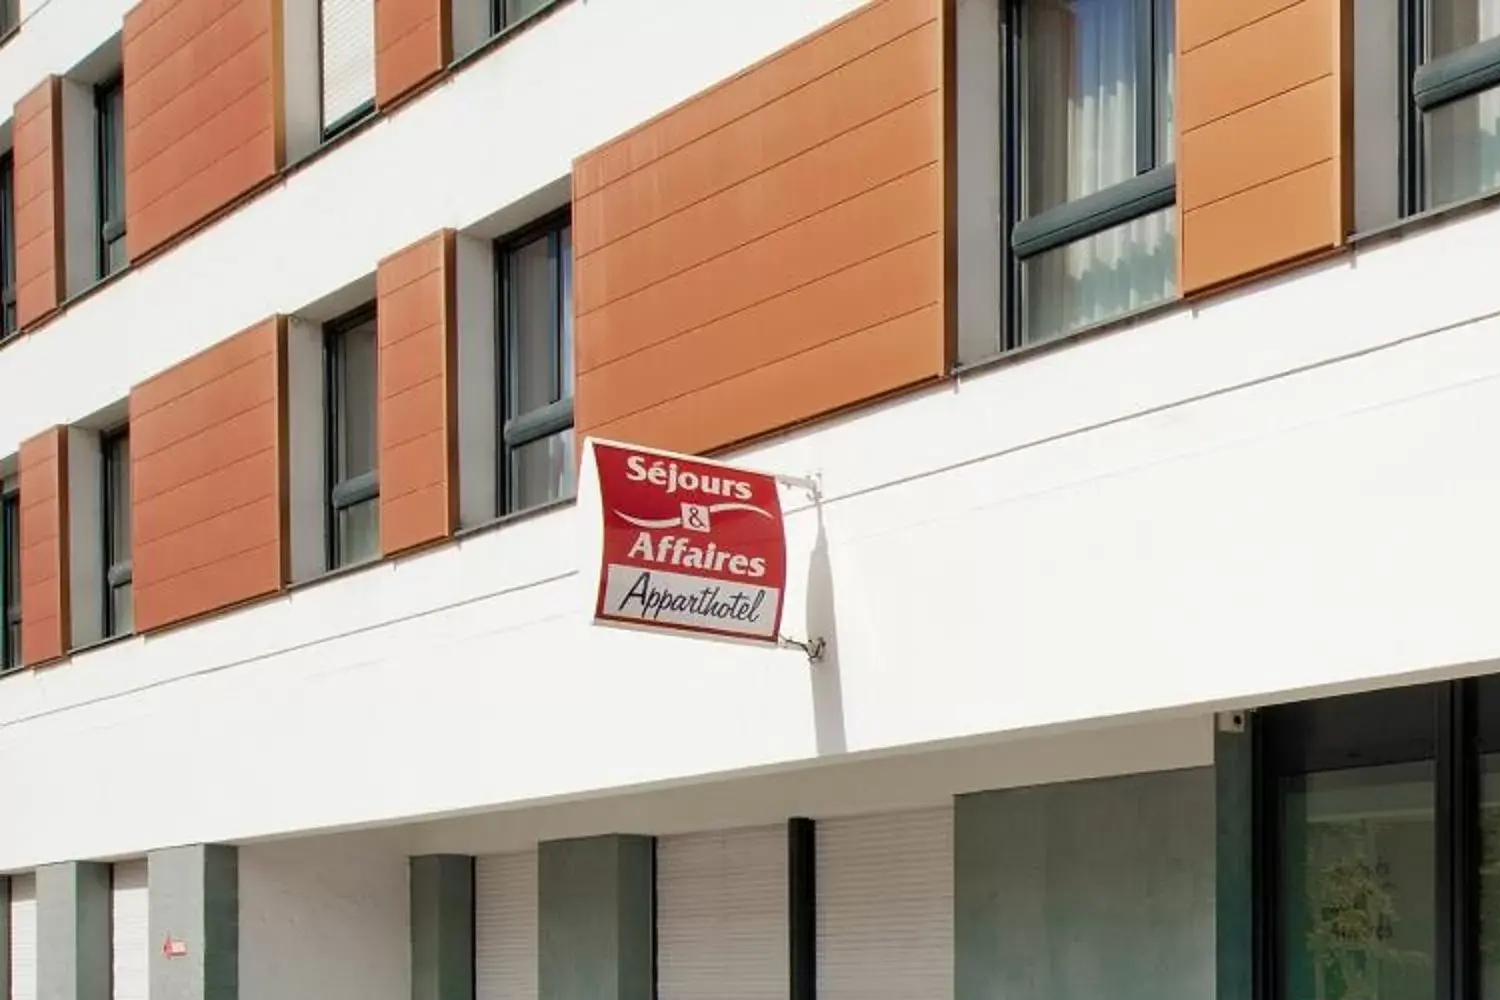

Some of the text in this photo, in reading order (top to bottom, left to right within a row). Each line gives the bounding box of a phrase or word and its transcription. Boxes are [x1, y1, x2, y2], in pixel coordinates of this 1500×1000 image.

[626, 455, 753, 499] Séjours
[688, 507, 705, 529] &
[627, 531, 767, 577] Affaires
[618, 572, 766, 623] Apparthotel
